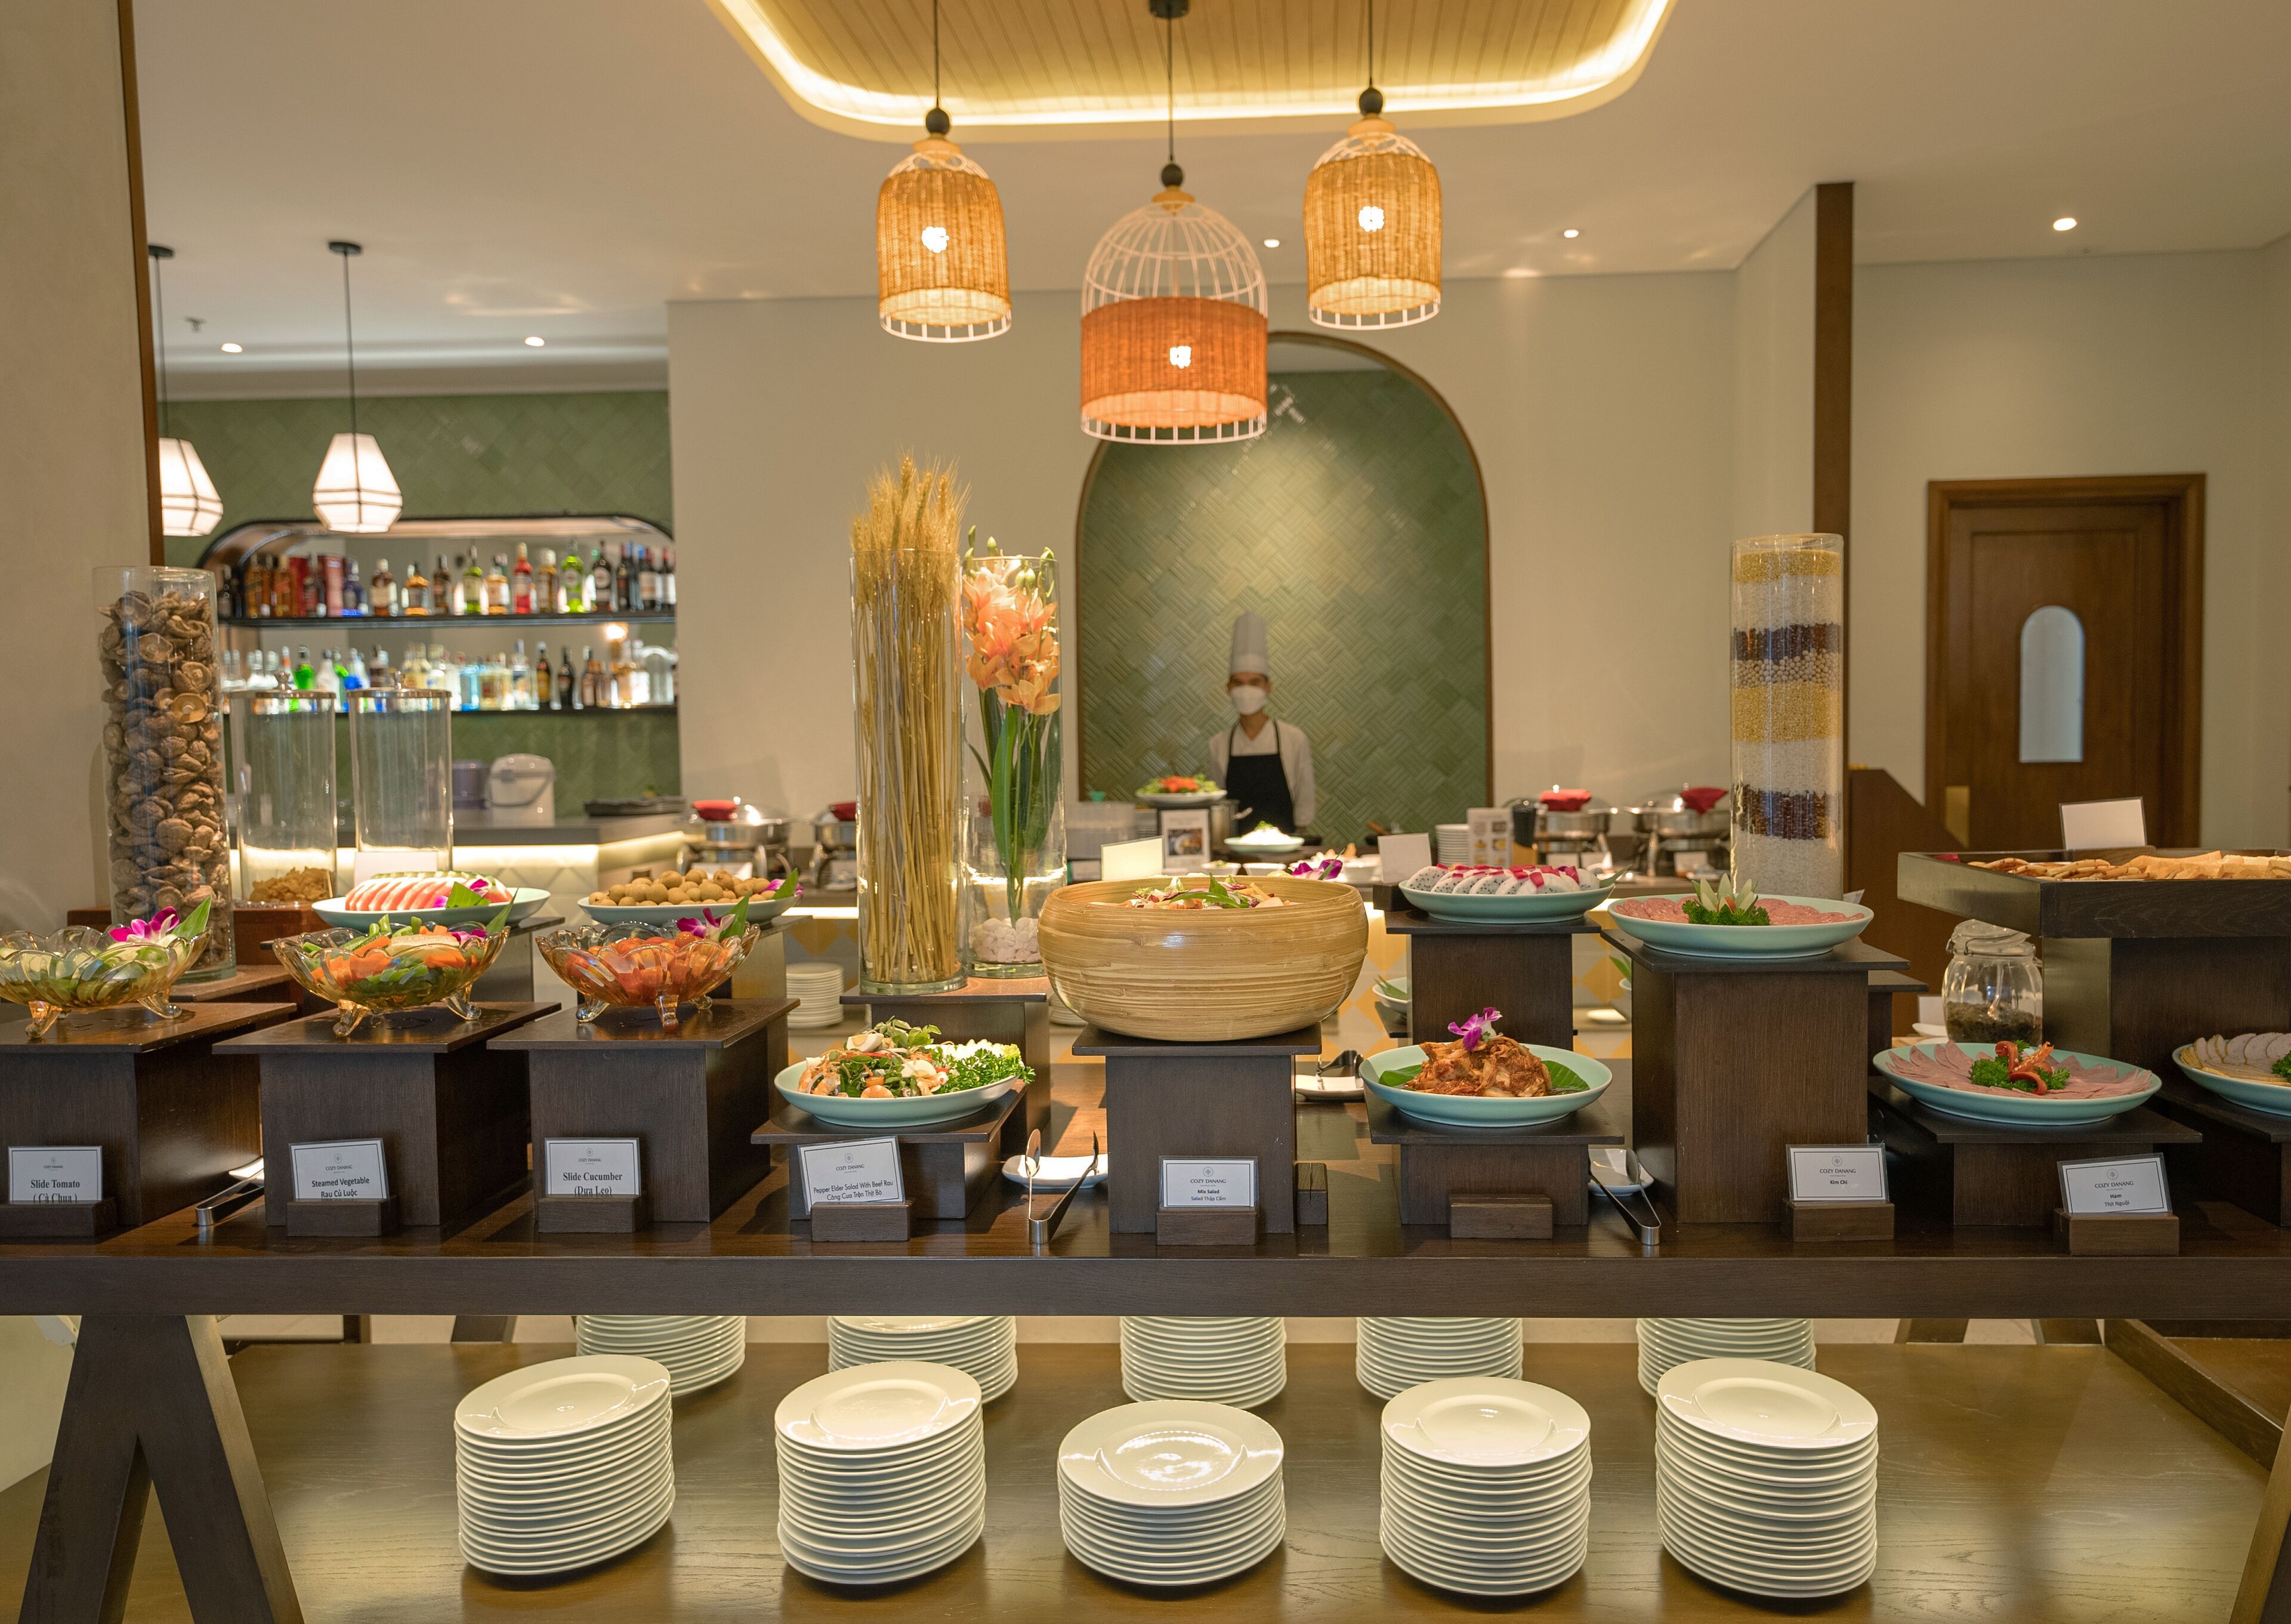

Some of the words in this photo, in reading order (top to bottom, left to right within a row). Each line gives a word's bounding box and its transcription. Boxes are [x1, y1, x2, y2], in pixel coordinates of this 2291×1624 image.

[563, 1172, 581, 1181] Slide
[583, 1172, 622, 1181] Cucumber
[30, 1180, 49, 1188] Slide
[51, 1180, 80, 1188] Tomato
[311, 1179, 338, 1187] Steamed
[340, 1177, 369, 1186] Vegetable
[343, 1189, 357, 1197] Luộc
[595, 1186, 612, 1195] Leo)
[51, 1193, 72, 1202] Chua
[827, 1193, 841, 1201] Càng
